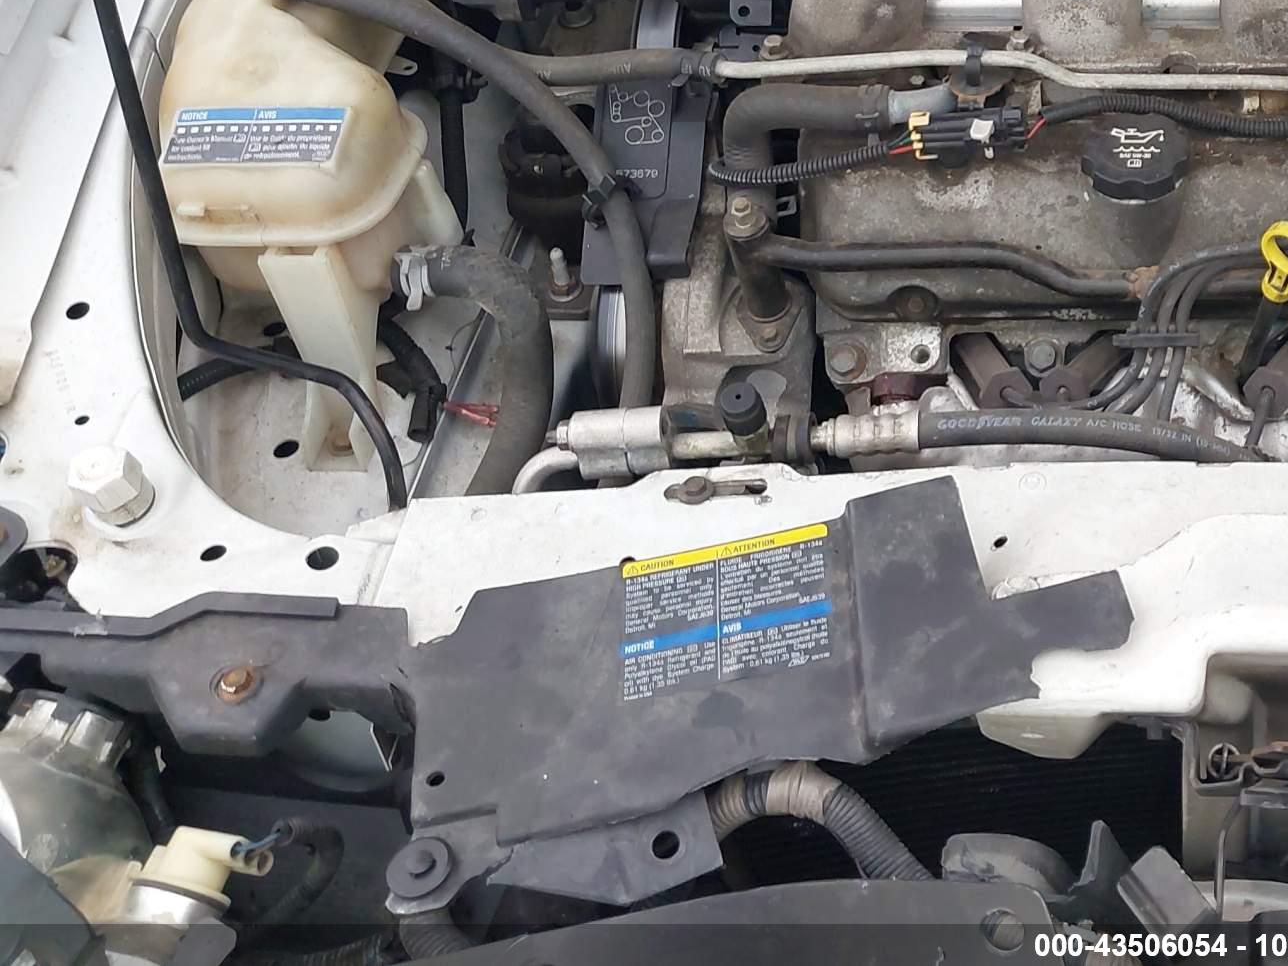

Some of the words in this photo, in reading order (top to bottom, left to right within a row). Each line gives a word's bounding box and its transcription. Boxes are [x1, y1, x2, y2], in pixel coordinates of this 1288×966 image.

[181, 111, 208, 120] NOTICE
[258, 110, 278, 119] AVIS
[937, 416, 1021, 430] GOODYEAR
[1031, 416, 1081, 428] GALAXY
[1086, 418, 1107, 428] A/C
[1112, 421, 1142, 432] HOSE
[733, 538, 775, 553] ATTENTION
[640, 559, 674, 571] CAUTION
[692, 562, 714, 572] UNDER
[720, 563, 737, 573] SOUS
[738, 559, 757, 569] HAUTE
[760, 553, 789, 565] PRESSION
[771, 565, 800, 577] personnel
[642, 577, 674, 588] PRESSURE
[676, 579, 702, 589] serviced
[706, 577, 714, 585] by
[769, 575, 780, 583] Des
[800, 574, 824, 584] peuvent
[660, 597, 681, 606] service
[688, 590, 714, 600] methods
[661, 588, 691, 599] personnel
[666, 602, 691, 612] personal
[722, 622, 742, 634] AVIS
[624, 640, 654, 654] NOTICE
[625, 658, 635, 666] AIR
[638, 648, 682, 662] CONDITIONING
[625, 665, 637, 674] only
[636, 677, 649, 685] with
[667, 668, 690, 679] System
[693, 664, 714, 673] Charge
